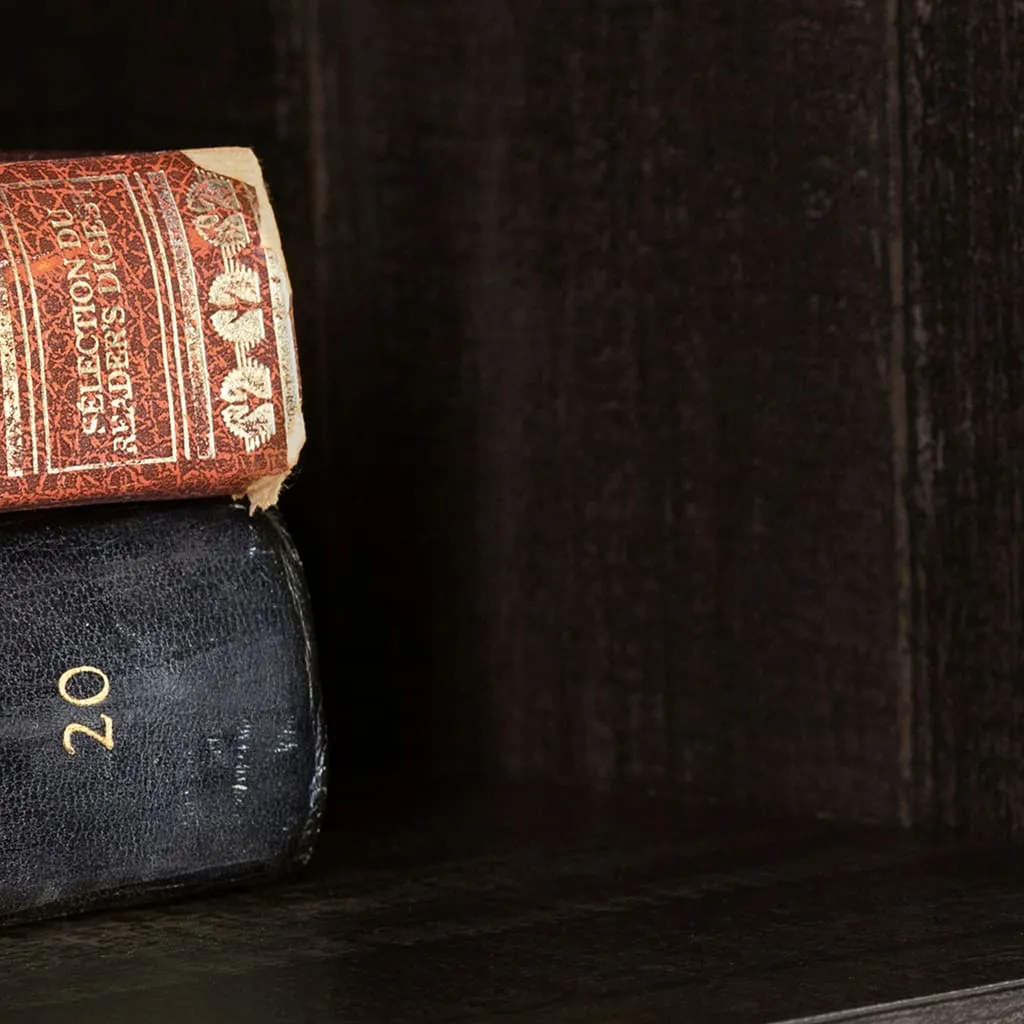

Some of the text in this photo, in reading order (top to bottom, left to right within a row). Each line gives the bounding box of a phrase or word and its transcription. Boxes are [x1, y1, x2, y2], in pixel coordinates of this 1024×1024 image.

[47, 208, 81, 249] DU
[102, 305, 138, 453] READER'S
[57, 665, 114, 755] 20
